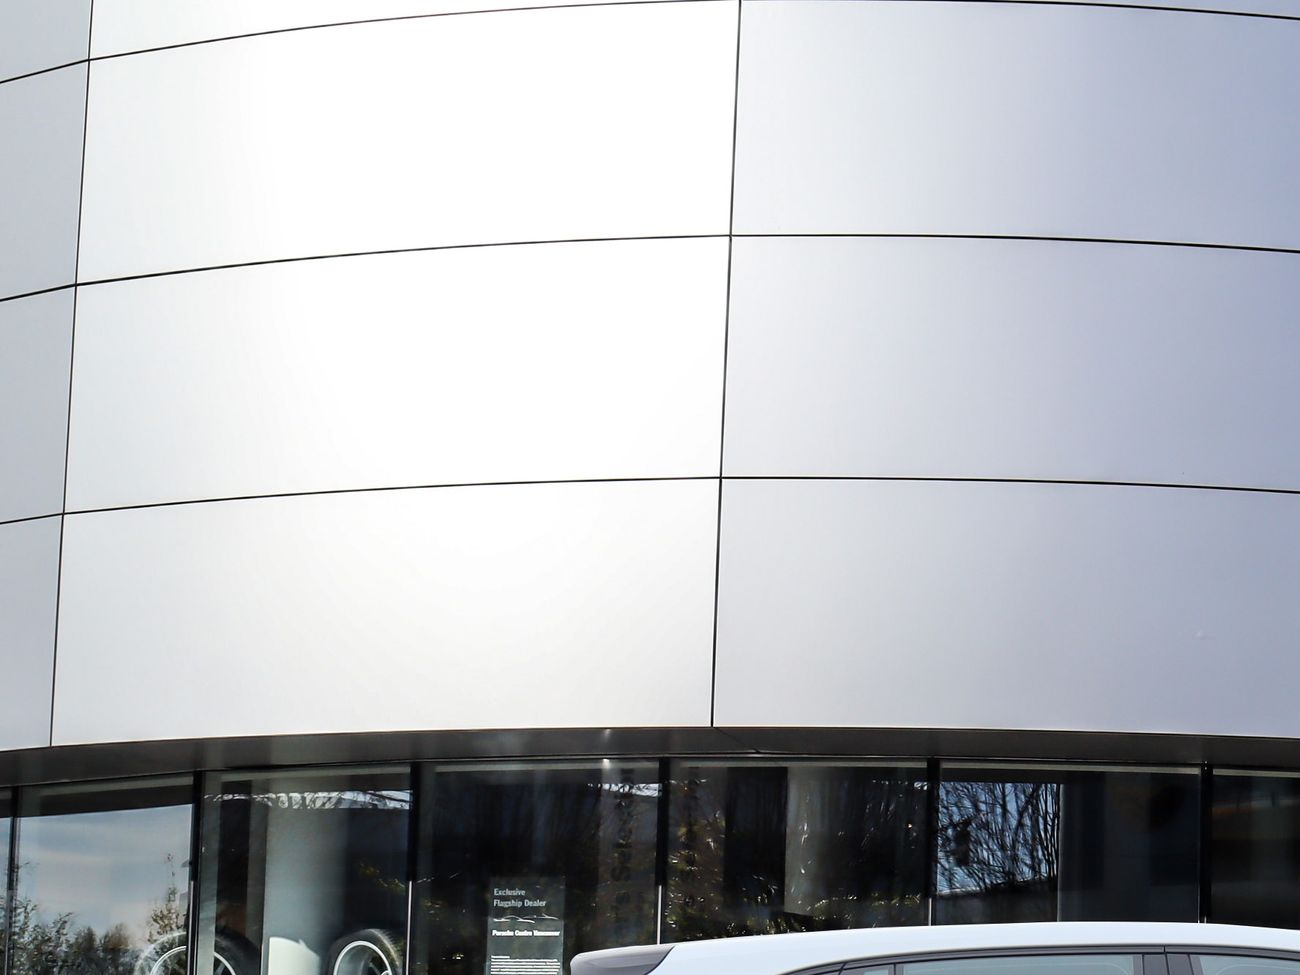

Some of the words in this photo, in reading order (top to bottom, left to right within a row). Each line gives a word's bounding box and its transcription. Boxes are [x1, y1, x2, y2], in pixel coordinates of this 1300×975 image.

[493, 888, 526, 896] Exclusive
[493, 899, 523, 908] Flagship
[524, 899, 546, 907] Dealer
